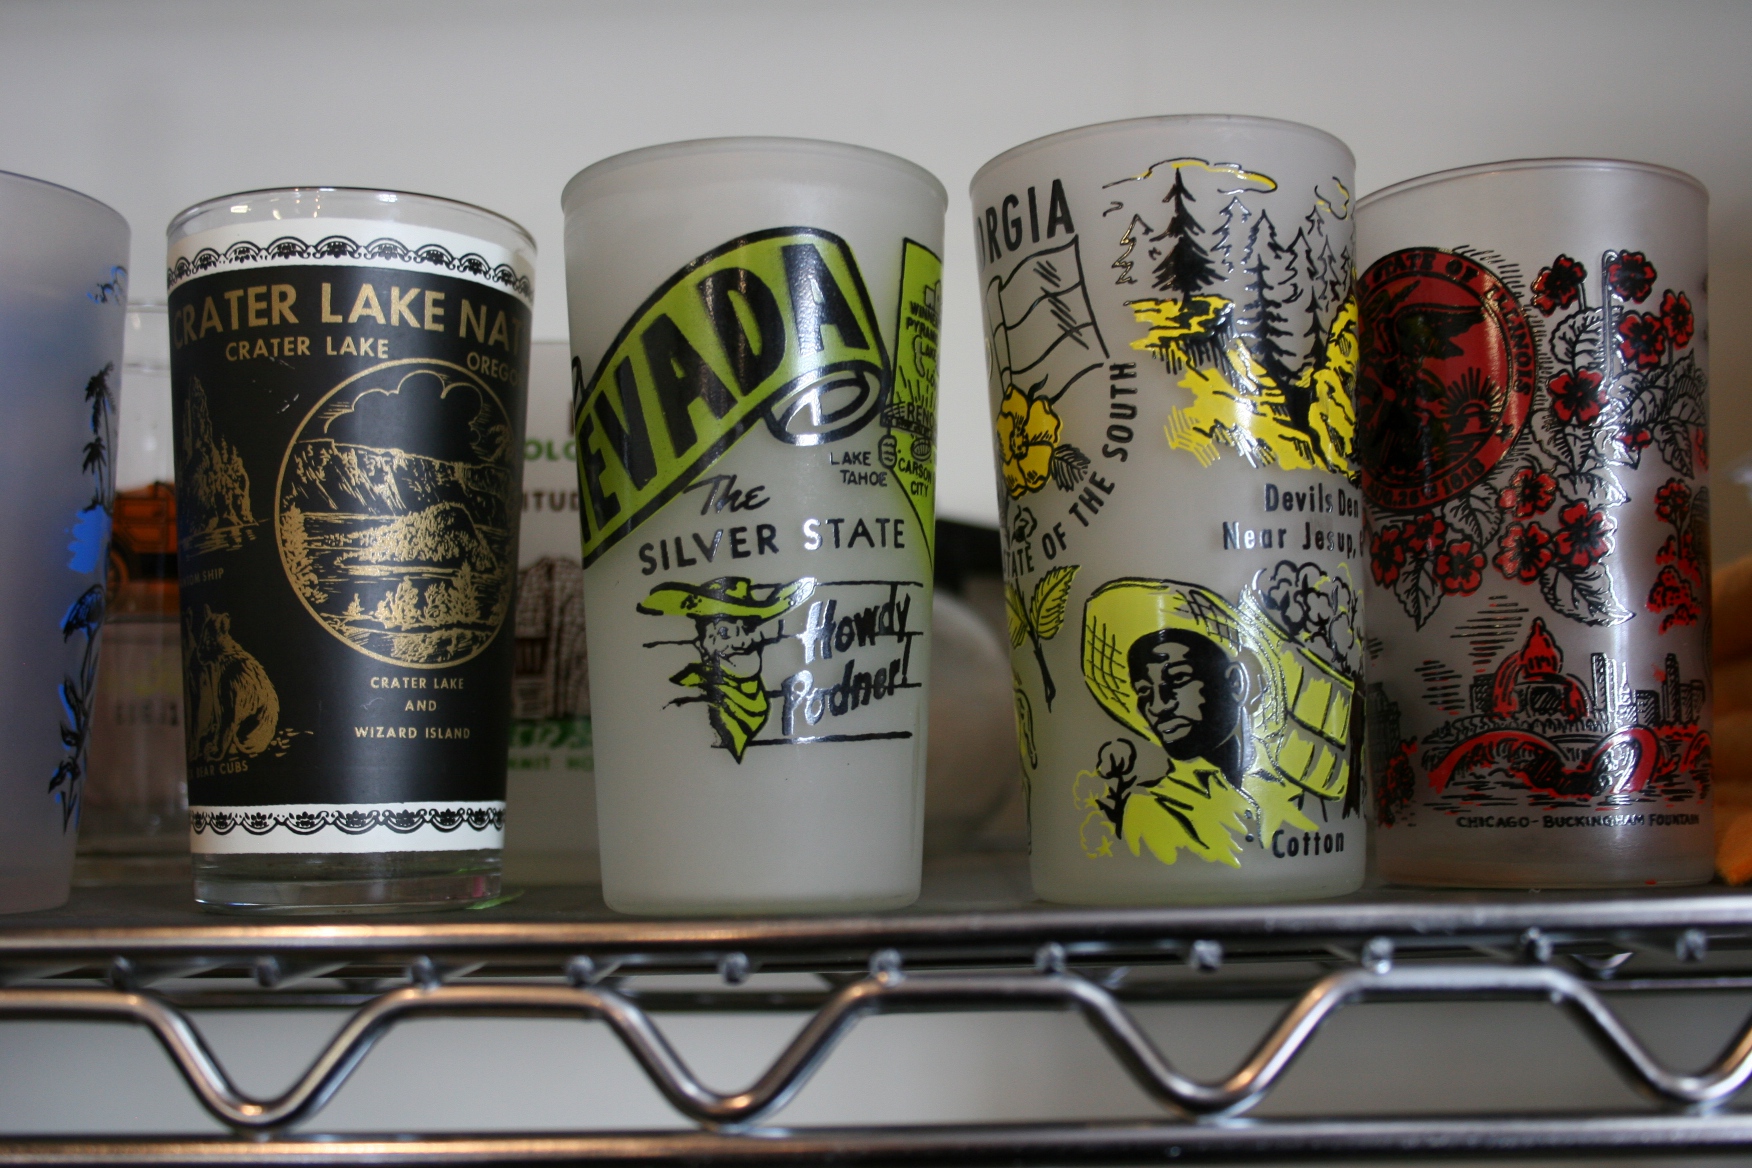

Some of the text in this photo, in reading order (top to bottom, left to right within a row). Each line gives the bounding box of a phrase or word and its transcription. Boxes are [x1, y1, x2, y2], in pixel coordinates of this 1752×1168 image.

[173, 283, 299, 349] CRATER
[321, 282, 445, 331] LAKE
[225, 337, 390, 362] CRATER LAKE
[829, 451, 872, 466] LAKE
[840, 469, 888, 487] TAHOE
[1003, 362, 1138, 578] TATE OF THE SOUTH
[683, 474, 770, 515] The
[910, 480, 929, 496] CITY
[1264, 482, 1359, 518] Devils Den
[638, 517, 906, 576] SILVER STATE
[1222, 521, 1287, 550] Near
[1302, 521, 1357, 559] Jesup,
[202, 567, 225, 582] SHIP
[800, 583, 911, 664] Howdy
[370, 676, 464, 690] CRATER LAKE
[404, 700, 437, 712] AND
[354, 726, 471, 739] WIZARD ISLAND
[219, 760, 249, 775] CUBS
[1542, 815, 1645, 828] BUCKINGHAM
[1272, 829, 1345, 859] Cotton
